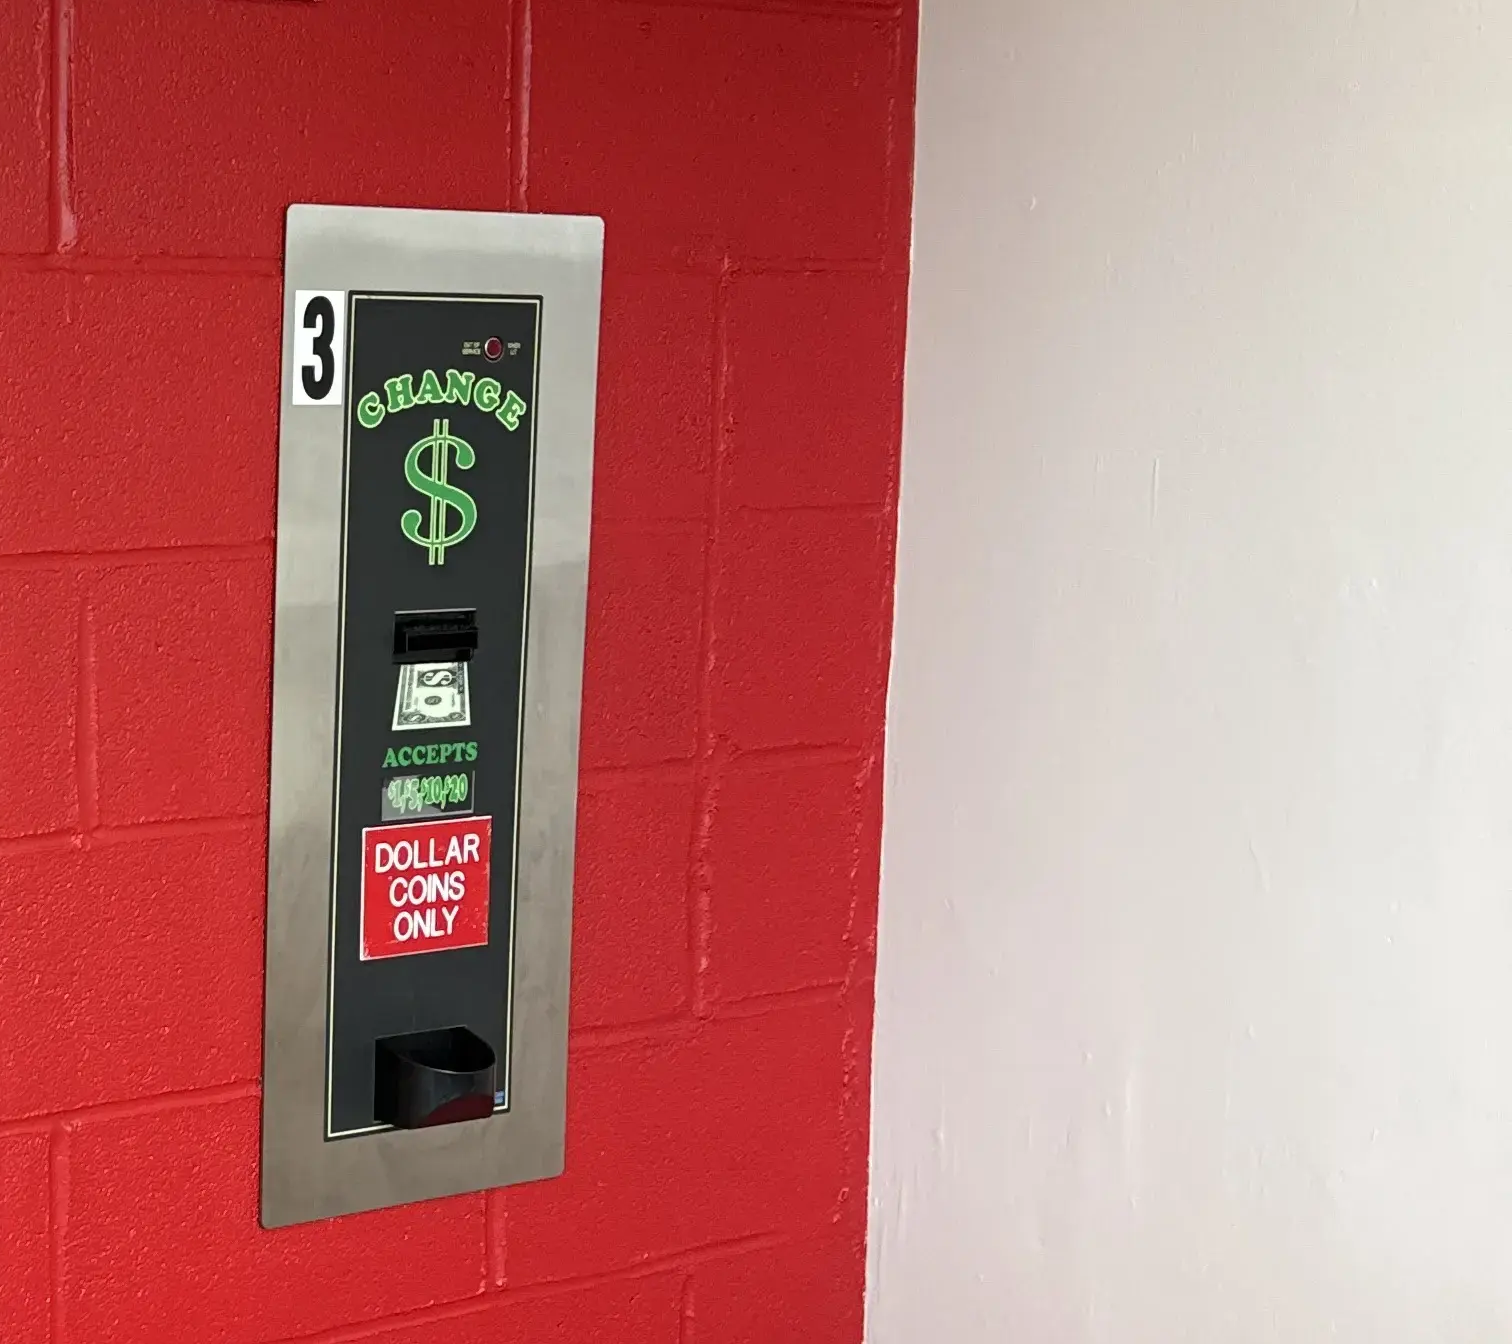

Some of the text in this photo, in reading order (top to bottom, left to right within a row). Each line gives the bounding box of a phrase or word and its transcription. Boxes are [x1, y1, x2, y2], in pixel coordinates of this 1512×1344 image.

[301, 295, 335, 400] 3
[357, 369, 526, 431] CHANGE
[381, 741, 478, 768] ACCEPTS
[375, 833, 480, 874] DOLLAR
[389, 870, 465, 908] COINS
[393, 905, 459, 943] ONLY
